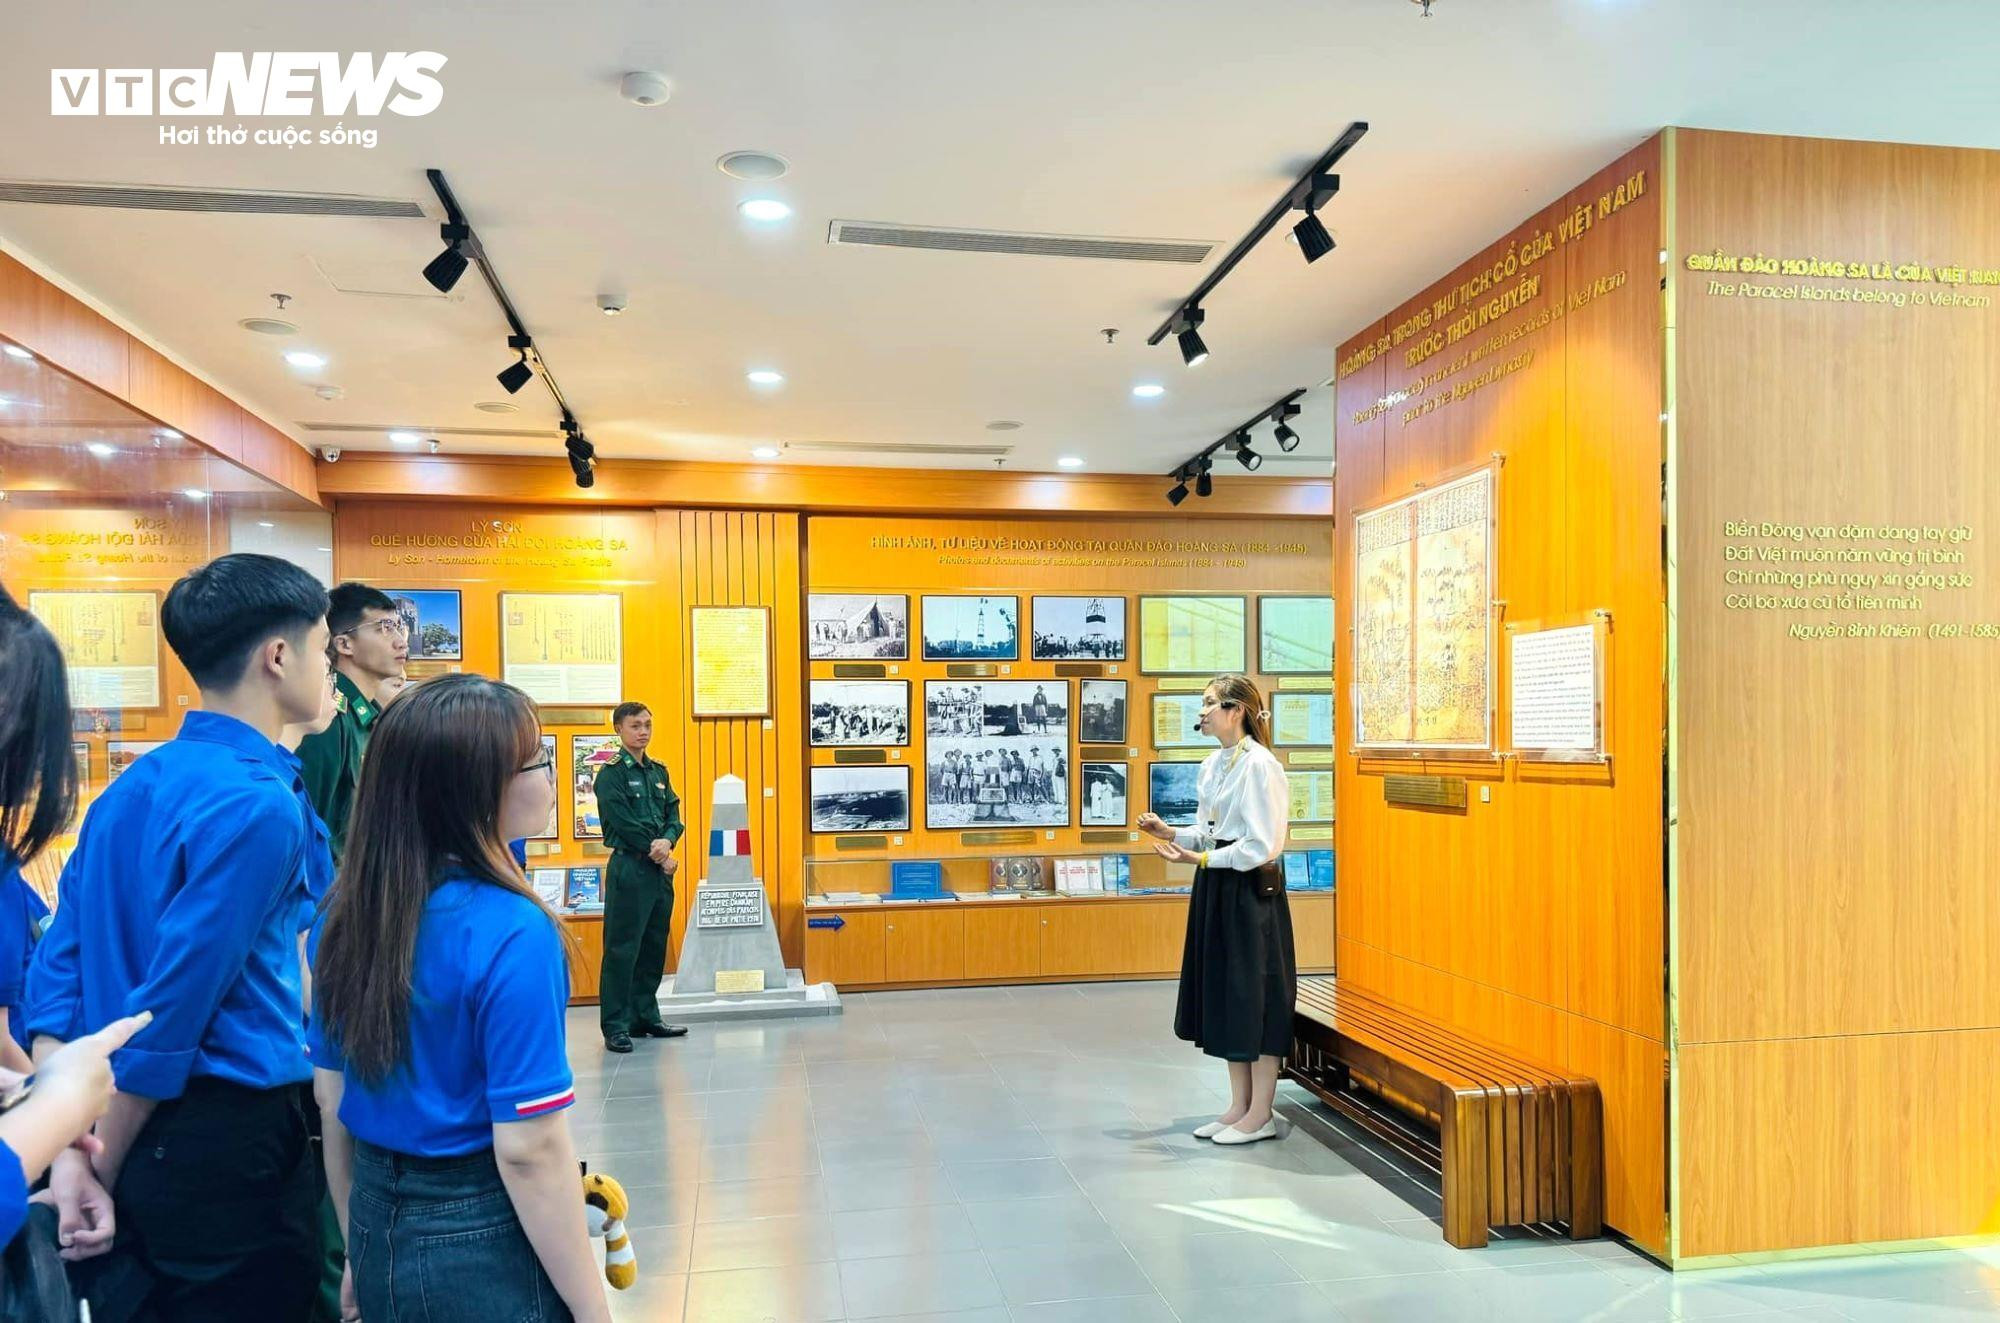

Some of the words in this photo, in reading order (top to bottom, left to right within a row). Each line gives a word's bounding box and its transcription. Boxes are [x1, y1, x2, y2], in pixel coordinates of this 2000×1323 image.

[1339, 342, 1376, 380] HOÀNG
[1393, 308, 1432, 346] TRONG
[1493, 241, 1518, 284] CỔ
[1520, 230, 1555, 266] CỦA
[1558, 204, 1593, 243] VIỆT
[1598, 170, 1645, 220] NAM
[1686, 248, 1738, 272] QUẦN
[1739, 252, 1779, 275] ĐẢO
[1782, 256, 1846, 279] HOÀNG
[1846, 261, 1870, 280] SA
[1871, 259, 1894, 281] LÀ
[1895, 260, 1933, 282] CỦA
[1934, 263, 1968, 288] VIỆT
[1593, 270, 1627, 299] Nam
[1708, 280, 1736, 297] The
[1738, 281, 1799, 300] Paracel
[1801, 285, 1850, 302] Islands
[1852, 287, 1907, 308] belong
[1911, 290, 1926, 305] to
[1929, 291, 1991, 308] Vietnam
[1479, 272, 1541, 327] NGUYỄN
[370, 533, 401, 547] QUÊ
[463, 532, 492, 548] CỦA
[1725, 518, 1758, 537] Biển
[1761, 522, 1804, 541] Đông
[1807, 526, 1836, 541] vạn
[1839, 524, 1875, 542] dặm
[1879, 525, 1919, 543] dang
[1922, 525, 1947, 543] tay
[1949, 525, 1973, 543] giữ
[1010, 538, 1045, 552] HOẠT
[1047, 538, 1085, 552] ĐỘNG
[1724, 544, 1754, 561] Đất
[1756, 544, 1788, 564] Việt
[1790, 547, 1834, 562] muôn
[1837, 547, 1873, 562] năm
[1876, 546, 1912, 566] vững
[1917, 548, 1931, 565] trị
[1932, 547, 1965, 563] bình
[1755, 569, 1804, 589] những
[1807, 570, 1837, 589] phù
[1840, 573, 1877, 590] nguy
[1881, 571, 1902, 586] xin
[1904, 569, 1945, 590] gắng
[1948, 571, 1973, 587] sức
[1725, 594, 1753, 609] Cõi
[1755, 594, 1778, 609] bờ
[1781, 596, 1809, 609] xưa
[1812, 594, 1833, 609] cũ
[1836, 590, 1852, 609] tổ
[1855, 594, 1883, 610] tiên
[1879, 623, 1922, 638] Khiêm
